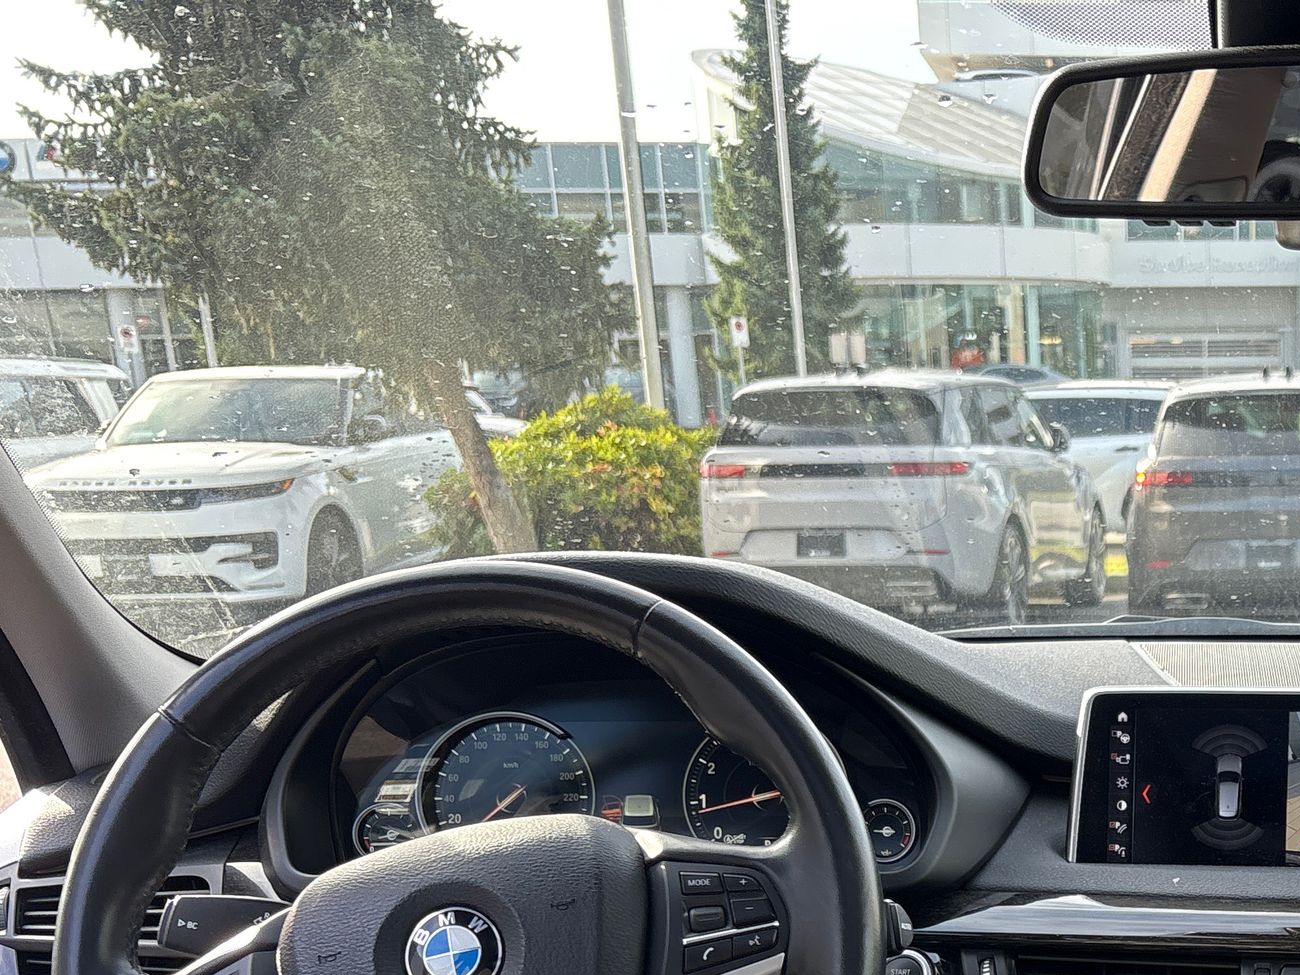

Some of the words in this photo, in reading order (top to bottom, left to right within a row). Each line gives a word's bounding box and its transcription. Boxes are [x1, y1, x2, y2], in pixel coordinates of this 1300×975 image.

[492, 733, 507, 741] 120
[514, 733, 529, 741] 140
[473, 742, 488, 750] 100
[535, 741, 549, 749] 160
[458, 756, 470, 764] 80
[550, 754, 564, 762] 180
[503, 761, 519, 769] km/h
[707, 762, 716, 774] 2
[559, 772, 575, 781] 200
[444, 794, 455, 803] 40
[563, 793, 579, 801] 220
[699, 793, 707, 808] 1
[448, 813, 462, 824] 20
[713, 826, 722, 839] 0
[687, 878, 711, 887] MODE
[186, 921, 199, 930] BC
[413, 911, 489, 945] BMW
[890, 968, 911, 975] START
